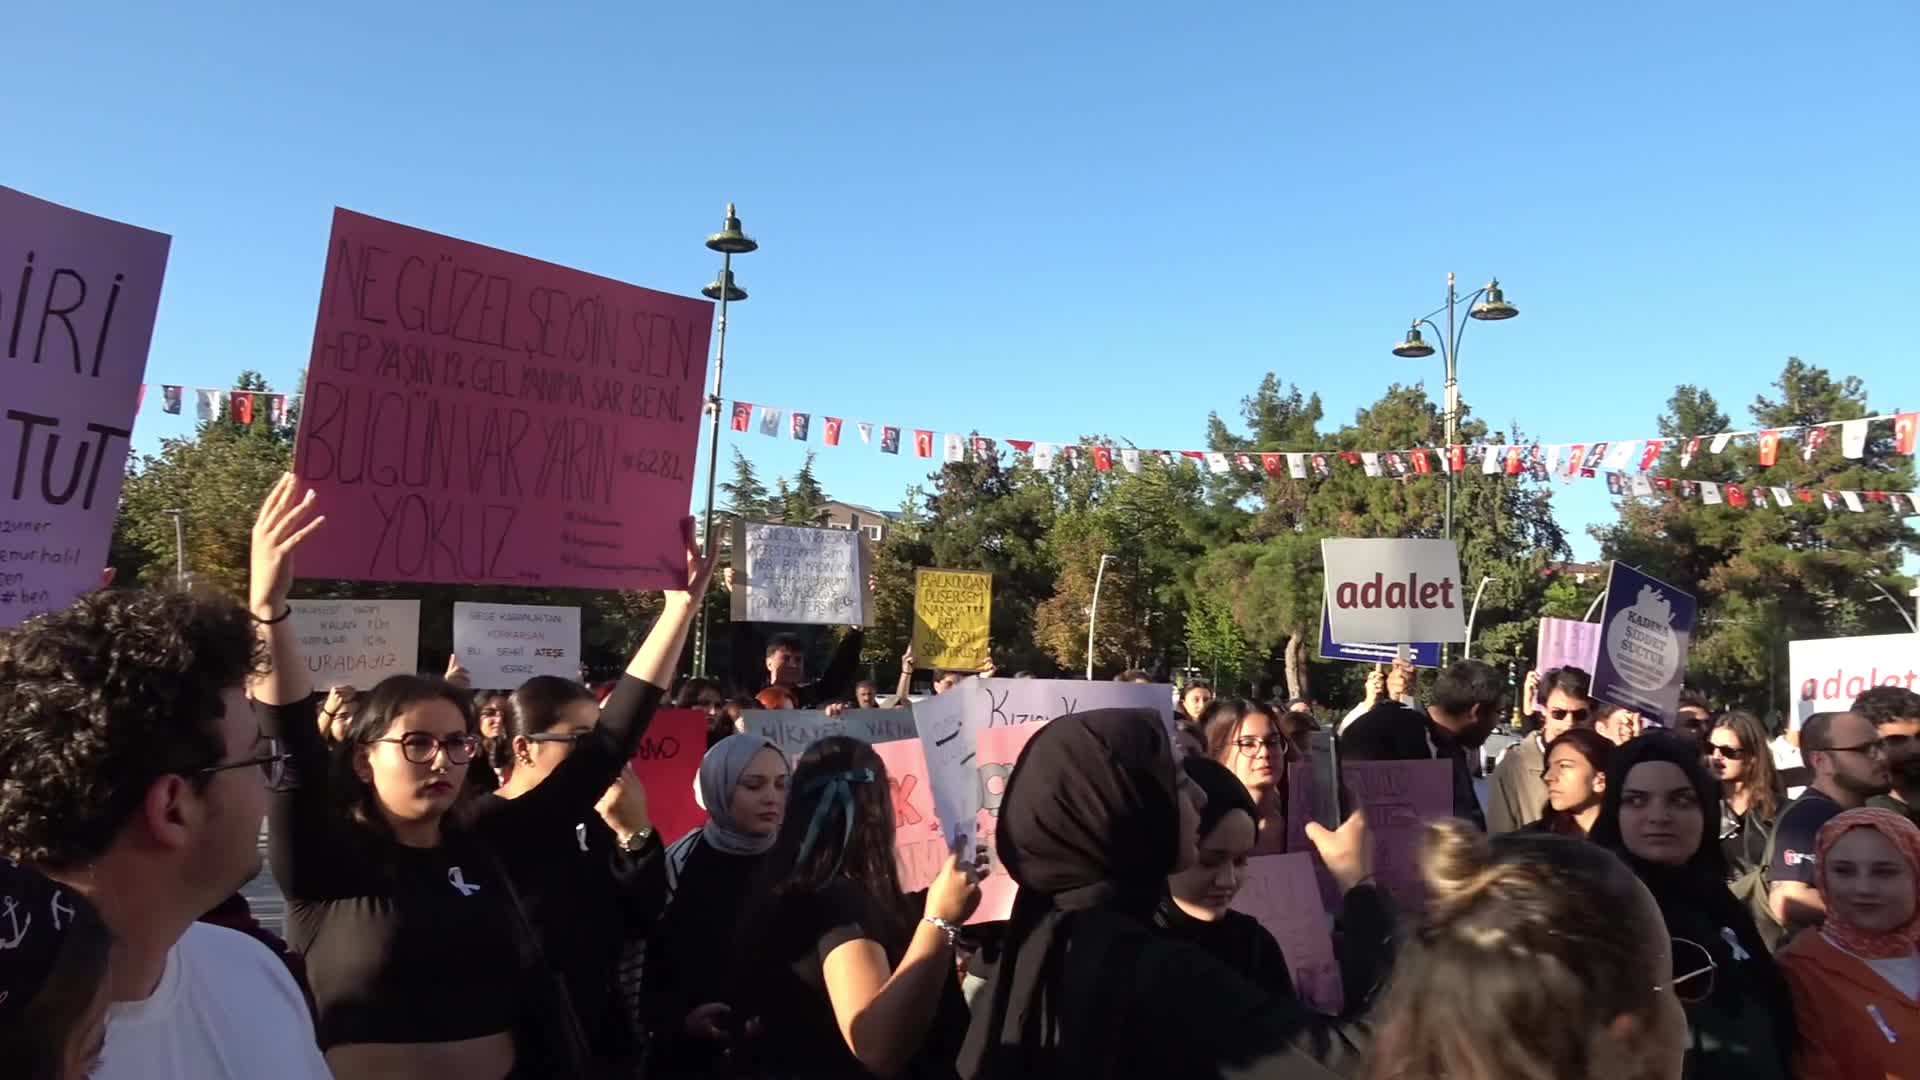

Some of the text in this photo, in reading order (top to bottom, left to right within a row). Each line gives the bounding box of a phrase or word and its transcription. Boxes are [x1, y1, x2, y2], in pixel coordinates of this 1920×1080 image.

[329, 238, 392, 328] NE
[394, 252, 522, 353] GÜZEL
[628, 312, 694, 382] SEN
[319, 331, 372, 373] HEP
[471, 358, 516, 399] GEL
[591, 379, 625, 415] SAR
[7, 408, 132, 510] TUT
[303, 381, 620, 505] BUGÜN VAR YARIN
[1336, 572, 1454, 609] adalet
[304, 652, 397, 674] URADAYIZ
